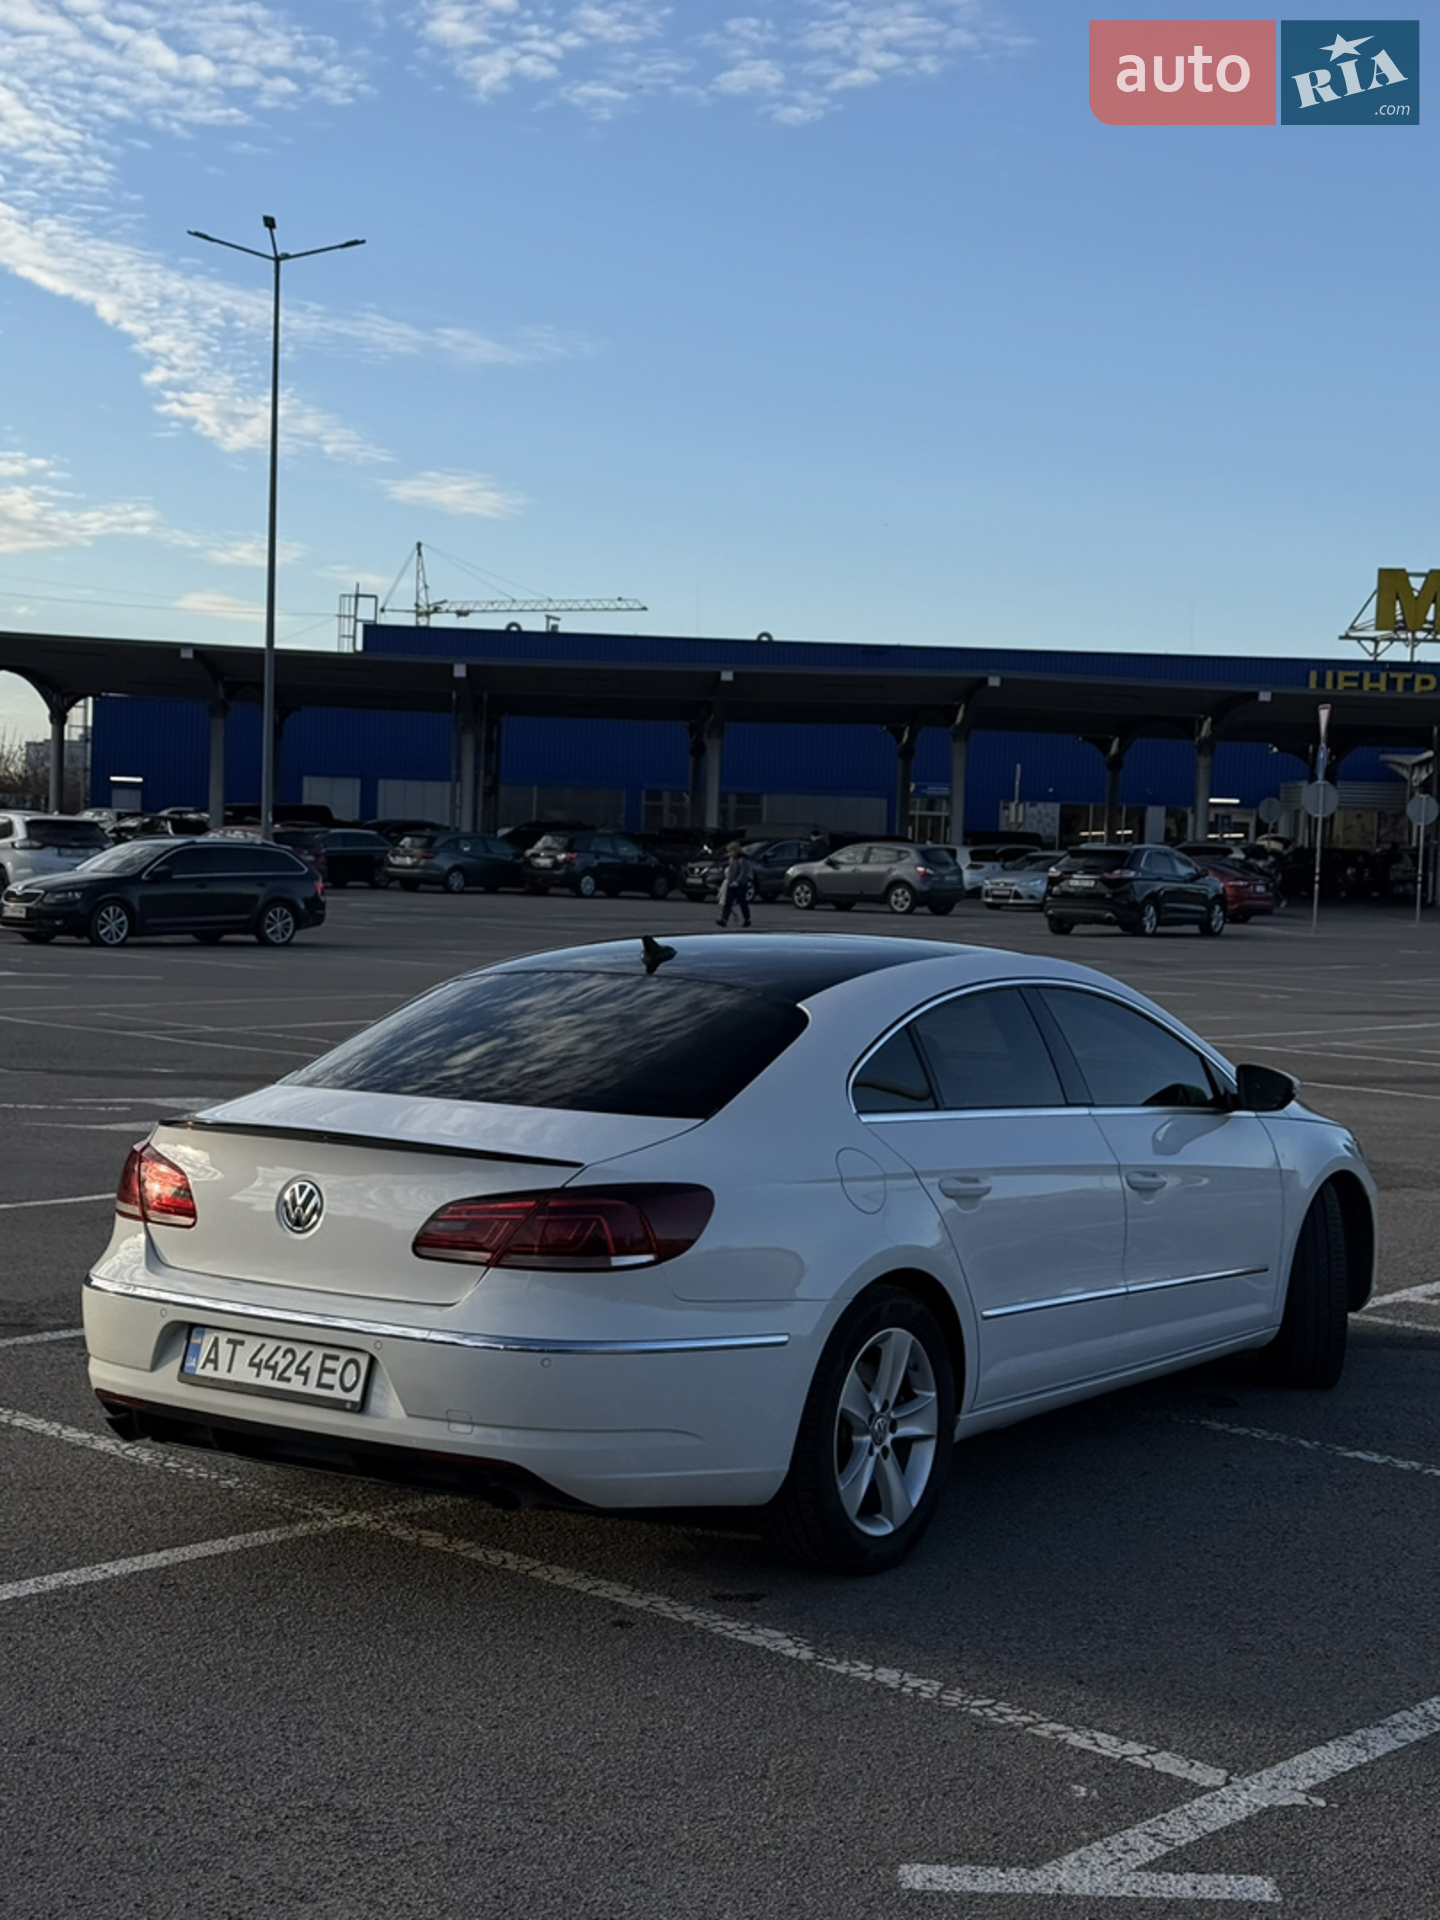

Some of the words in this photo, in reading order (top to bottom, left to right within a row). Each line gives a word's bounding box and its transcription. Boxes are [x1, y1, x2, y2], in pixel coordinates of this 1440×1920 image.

[200, 1335, 246, 1374] AT
[247, 1342, 314, 1387] 4424
[315, 1352, 362, 1394] EO
